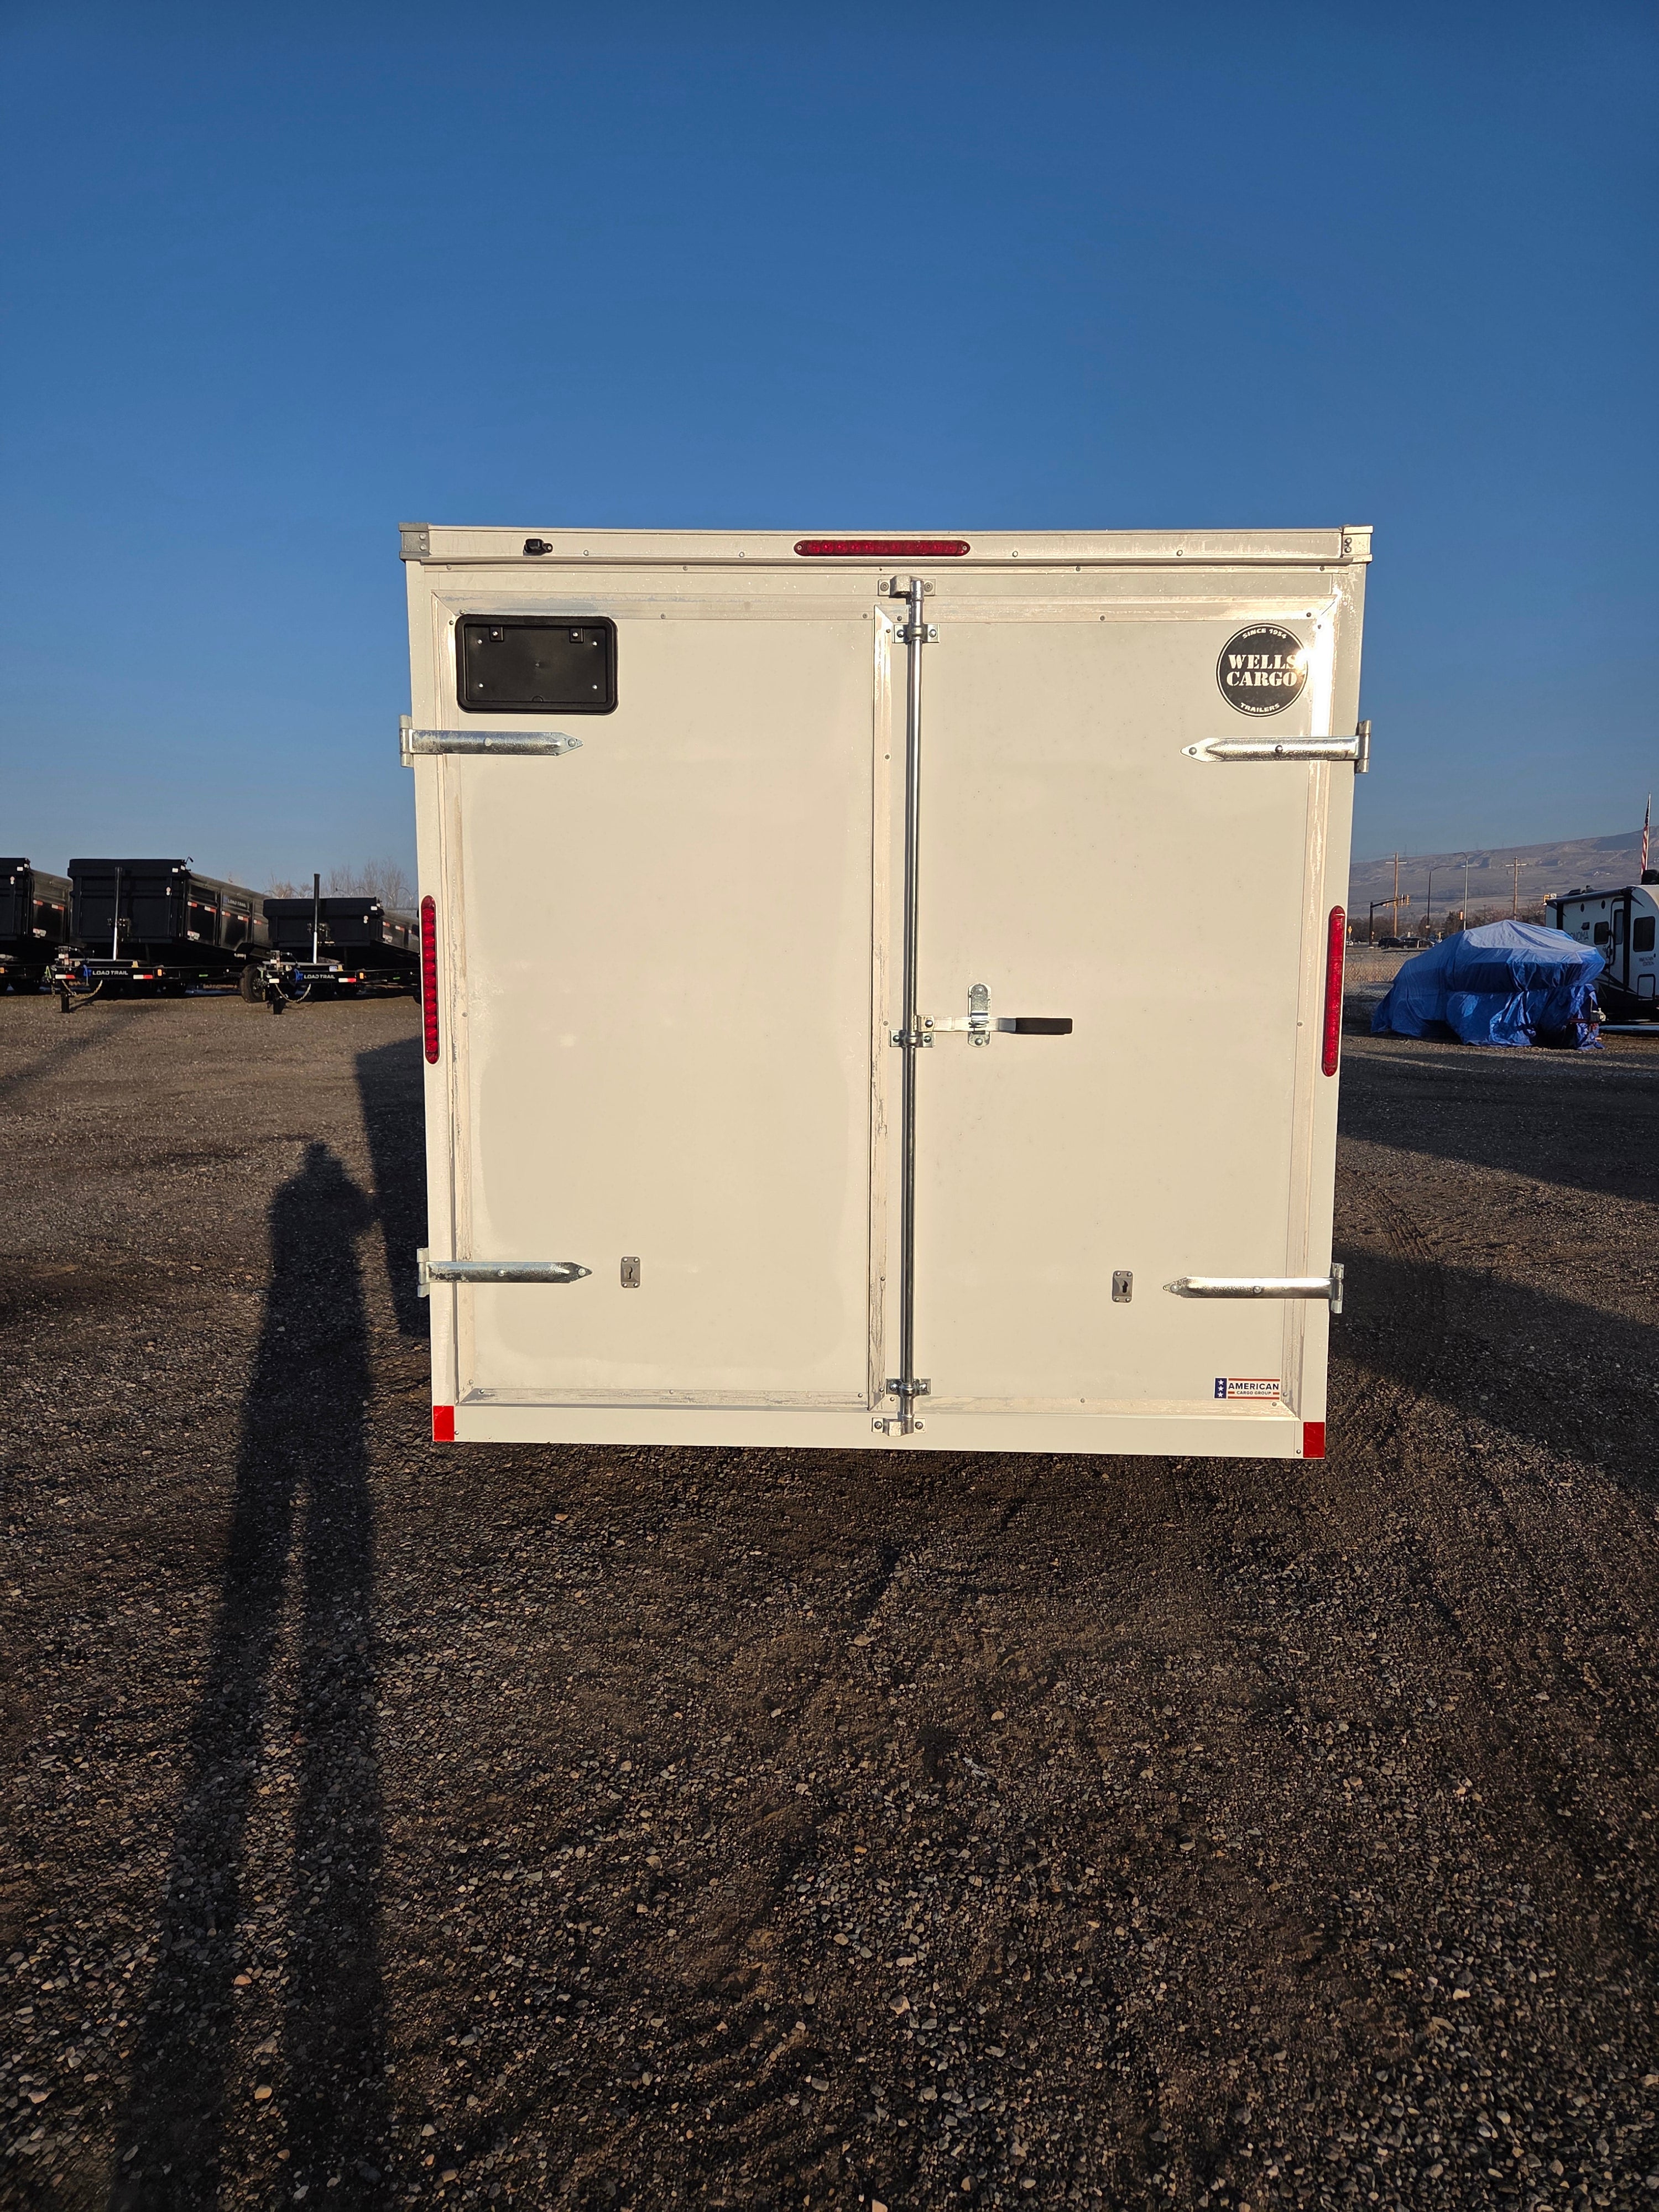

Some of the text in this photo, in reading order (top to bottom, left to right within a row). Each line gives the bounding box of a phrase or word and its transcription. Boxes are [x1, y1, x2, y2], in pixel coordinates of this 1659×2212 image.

[1242, 628, 1287, 639] SINCE 1954
[1228, 655, 1297, 669] WELLS
[1227, 671, 1297, 686] CARGO
[1240, 702, 1280, 712] TRAILERS
